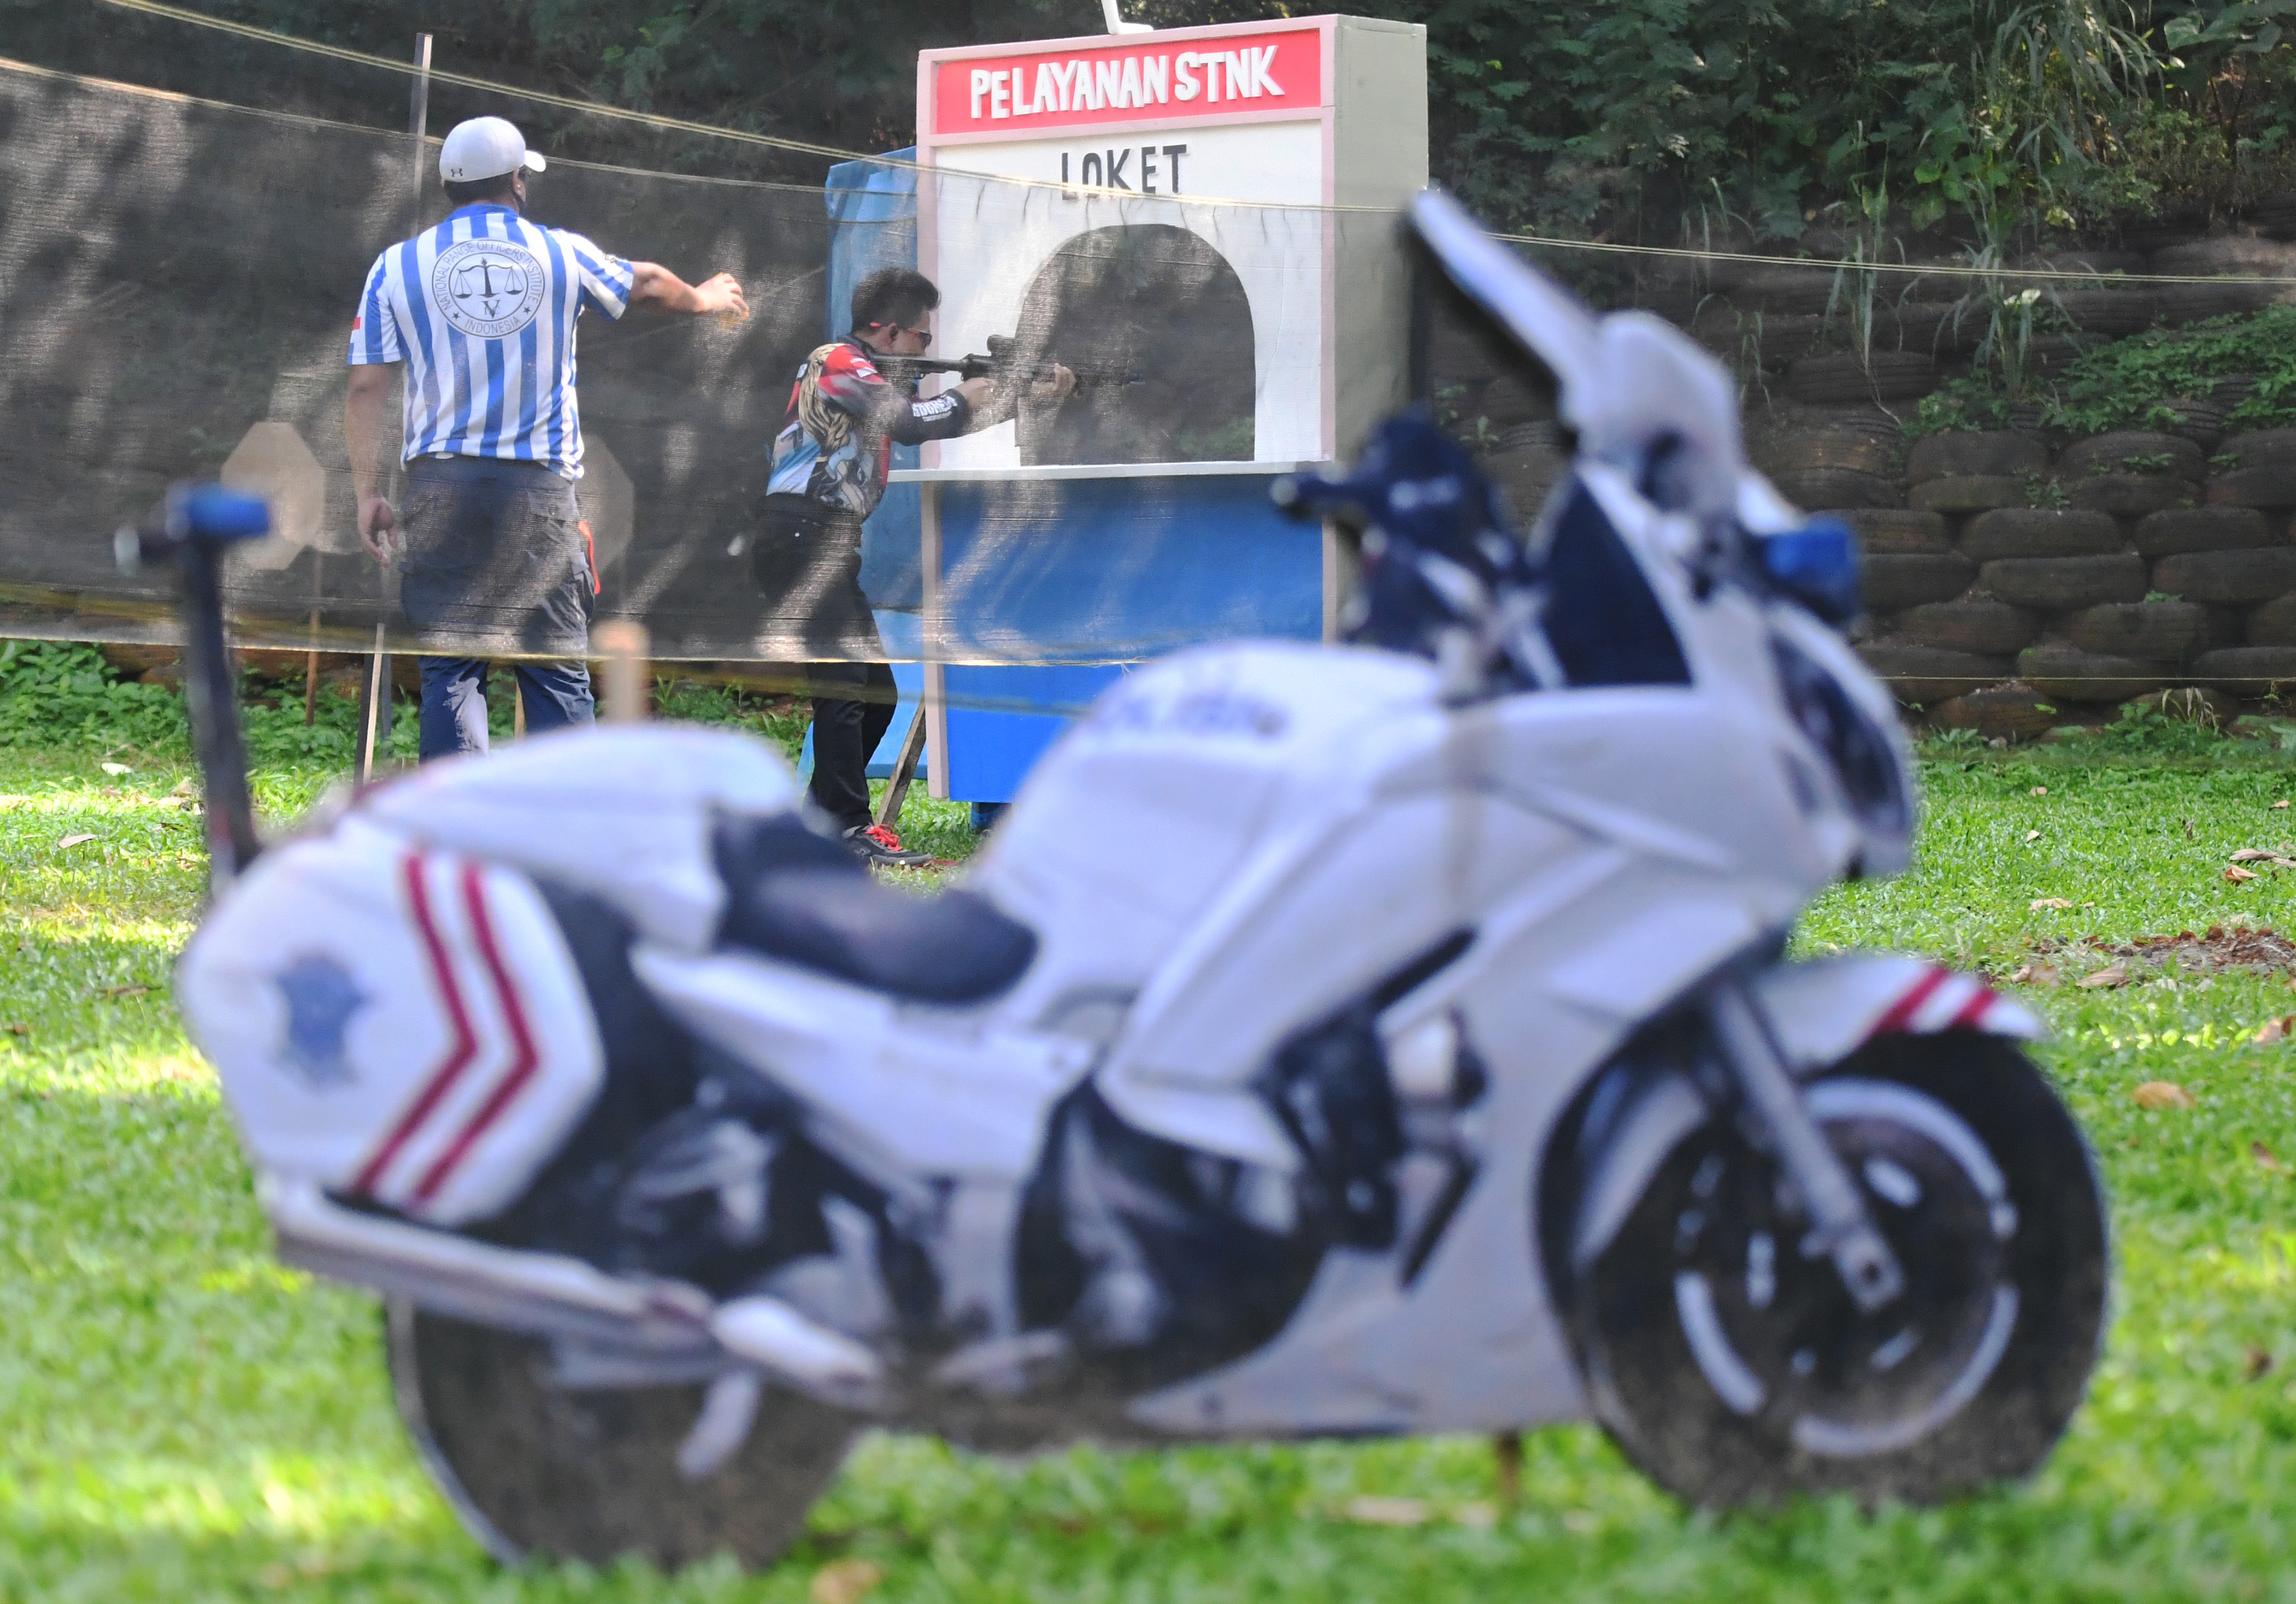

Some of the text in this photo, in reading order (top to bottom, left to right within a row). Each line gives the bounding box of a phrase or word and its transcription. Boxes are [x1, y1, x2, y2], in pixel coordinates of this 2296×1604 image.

[971, 45, 1285, 119] PELAYANAN STNK
[1061, 143, 1188, 201] LOKET
[435, 242, 542, 311] NATIONAL RANGE OFFICERS INSTITUTE
[465, 316, 522, 335] INDONESIA
